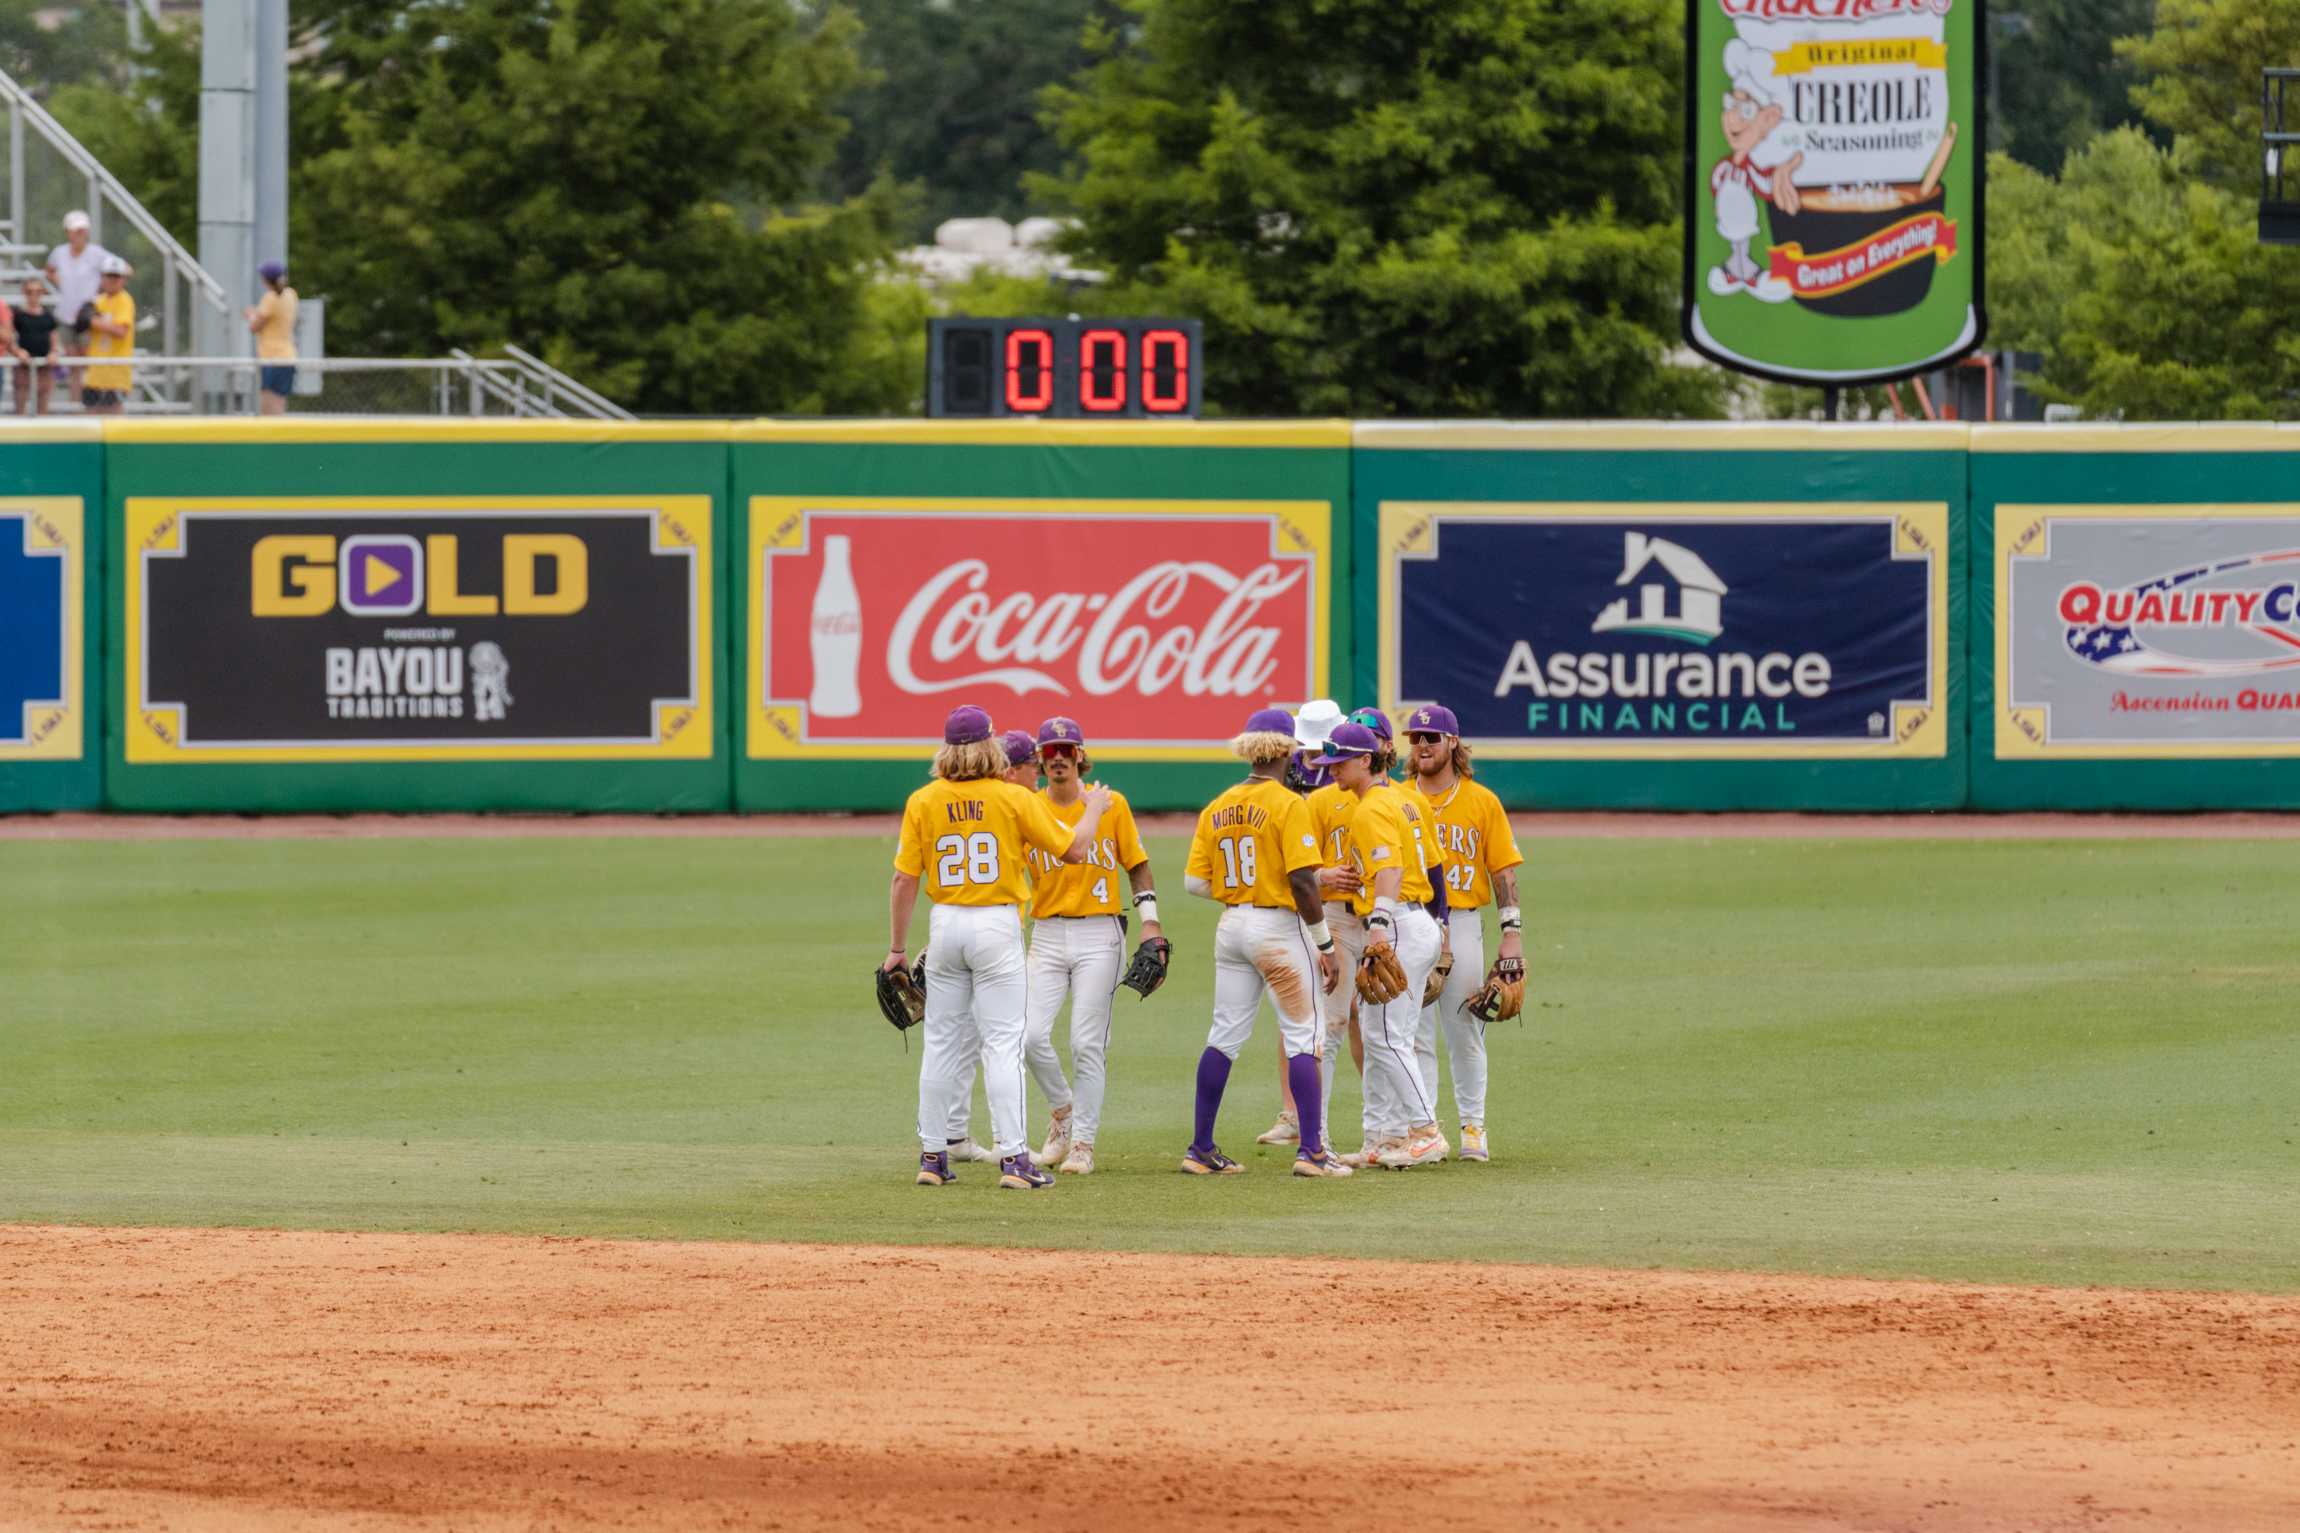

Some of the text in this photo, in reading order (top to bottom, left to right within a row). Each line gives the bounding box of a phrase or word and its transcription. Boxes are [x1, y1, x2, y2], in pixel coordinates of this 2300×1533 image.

[1794, 76, 1932, 124] CREOLE
[1805, 128, 1922, 151] Seasoning
[1797, 217, 1938, 288] Great on Everything!
[887, 559, 1306, 696] Coca-Cola
[326, 647, 464, 695] BAYOU
[1494, 640, 1831, 698] Assurance
[326, 696, 464, 718] TRADITIONS
[1528, 703, 1796, 731] FINANCIAL
[2111, 688, 2300, 712] Ascension QUA
[946, 800, 984, 823] KLING
[936, 832, 1000, 888] 28
[1218, 834, 1257, 888] 18
[1446, 864, 1475, 892] 47
[1091, 877, 1109, 904] 4
